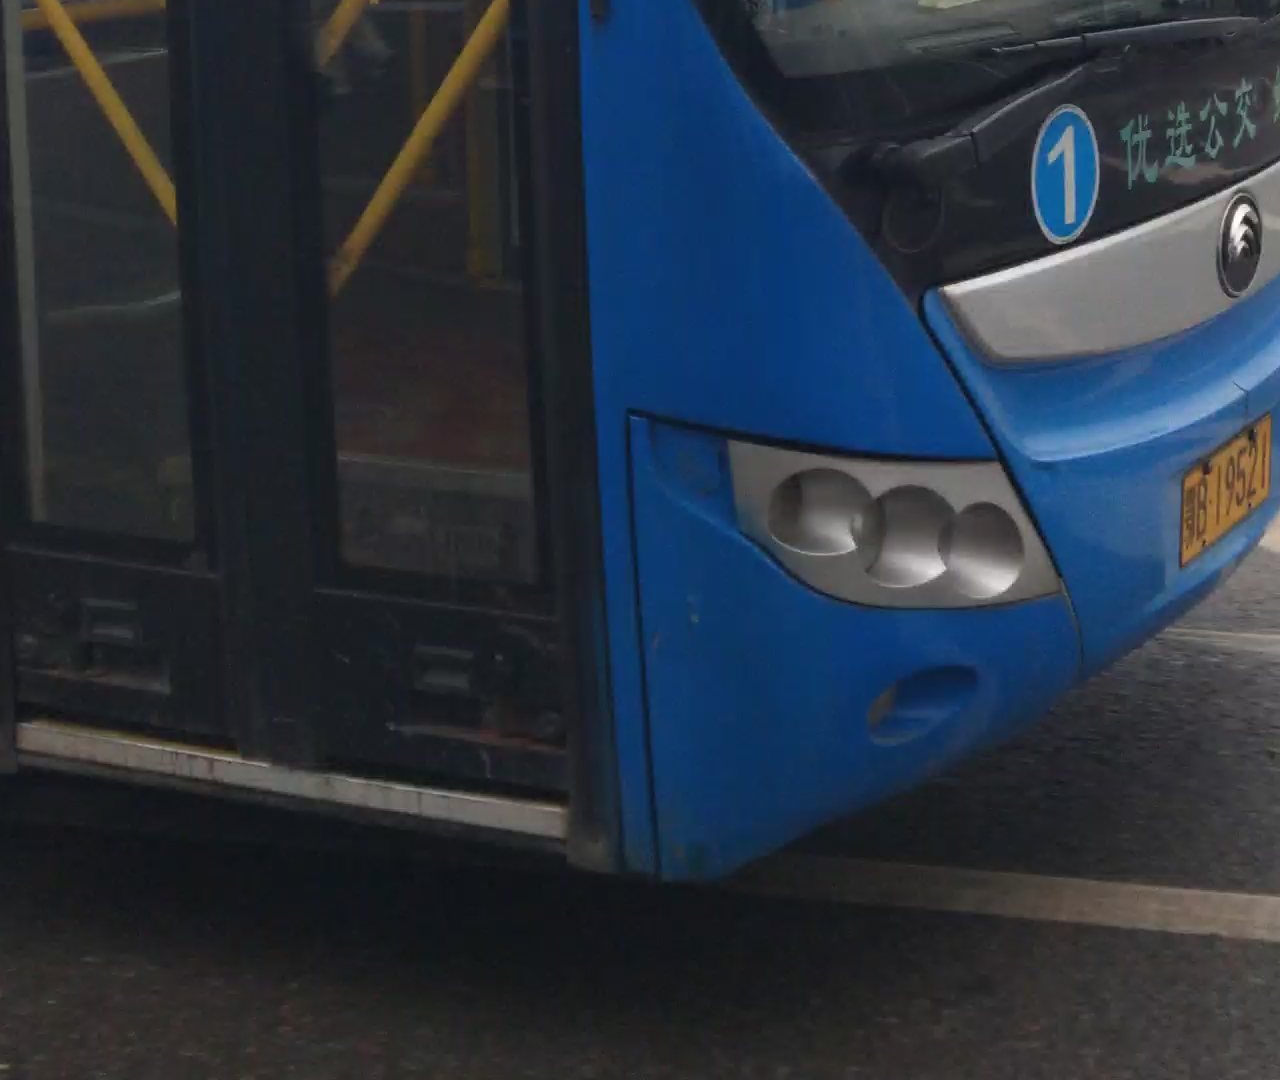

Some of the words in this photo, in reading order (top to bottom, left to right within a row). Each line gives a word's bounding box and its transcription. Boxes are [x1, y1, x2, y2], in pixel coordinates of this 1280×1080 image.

[1047, 123, 1076, 226] 1
[1119, 76, 1257, 191] 优选公交
